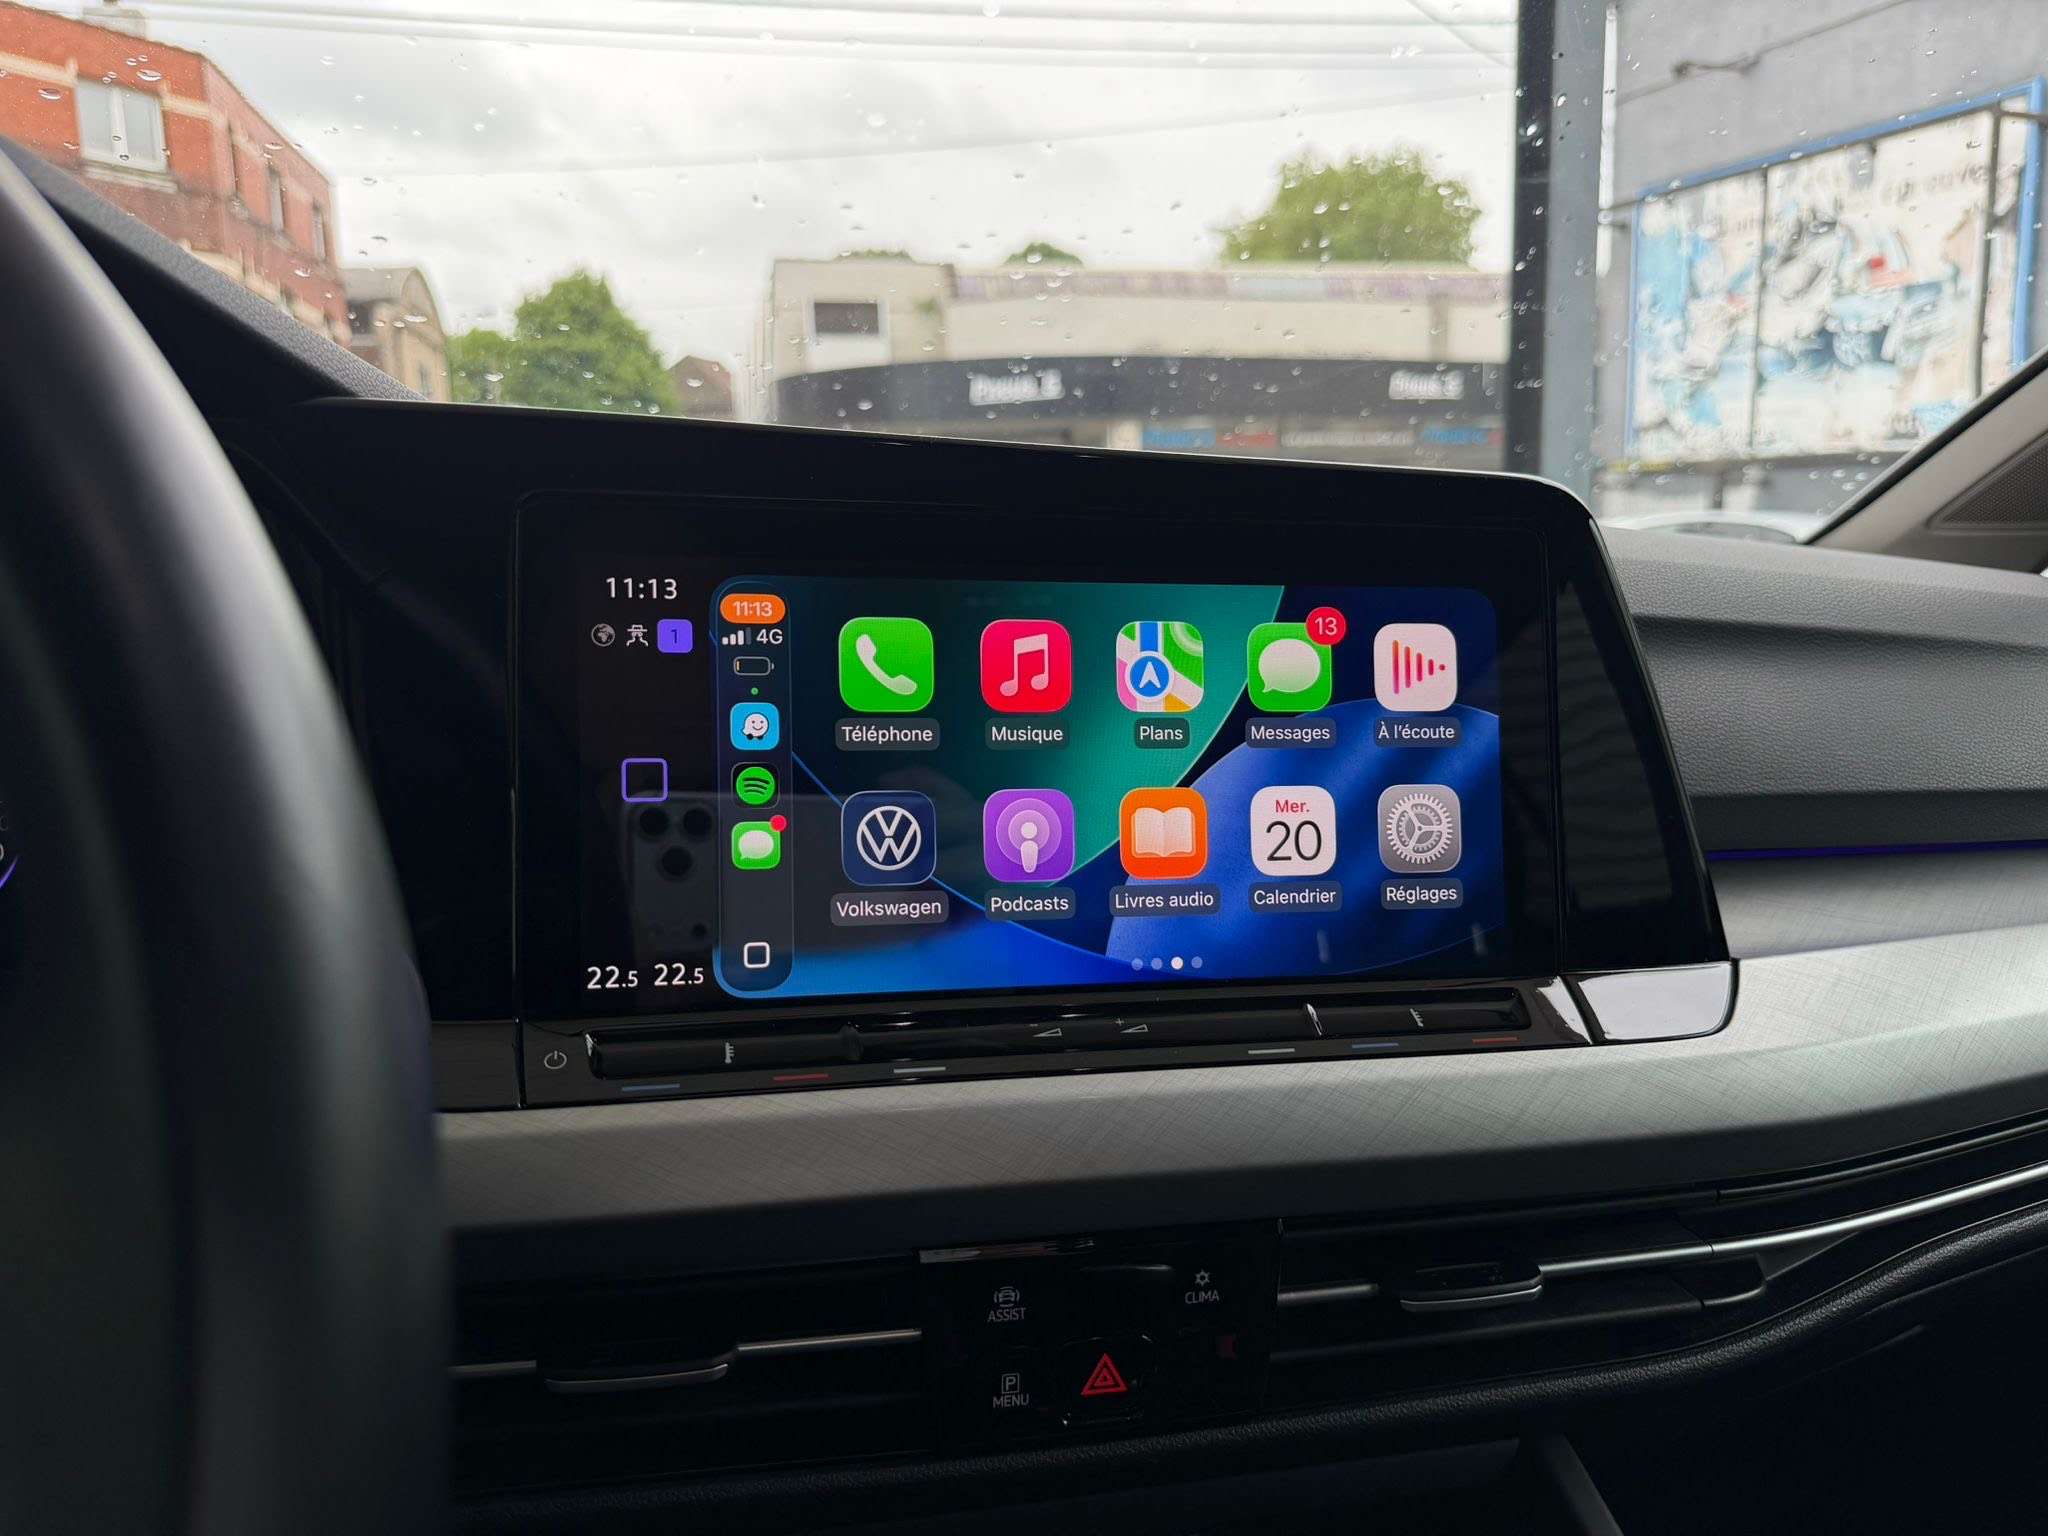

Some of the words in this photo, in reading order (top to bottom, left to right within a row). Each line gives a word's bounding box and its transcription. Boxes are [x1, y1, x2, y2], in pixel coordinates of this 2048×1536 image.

[606, 577, 678, 600] 11:13
[732, 601, 773, 618] 11:13
[1314, 617, 1338, 636] 13
[756, 629, 784, 645] 4G
[841, 725, 933, 744] Téléphone
[991, 725, 1063, 744] Musique
[1139, 725, 1184, 741] Plans
[1250, 725, 1331, 743] Messages
[1377, 722, 1390, 739] À
[1274, 799, 1310, 814] Mer.
[1265, 820, 1322, 862] 20
[1114, 893, 1164, 909] Livres
[1168, 892, 1214, 908] audio
[1253, 889, 1336, 905] Calendrier
[1386, 885, 1457, 904] Réglages
[836, 898, 942, 918] Volkswagen
[990, 896, 1069, 914] Podcasts
[586, 965, 639, 989] 22.5
[653, 963, 704, 986] 22.5
[1184, 1289, 1220, 1305] CLIMA
[987, 1307, 1027, 1322] ASSIST
[992, 1394, 1030, 1408] MENU
